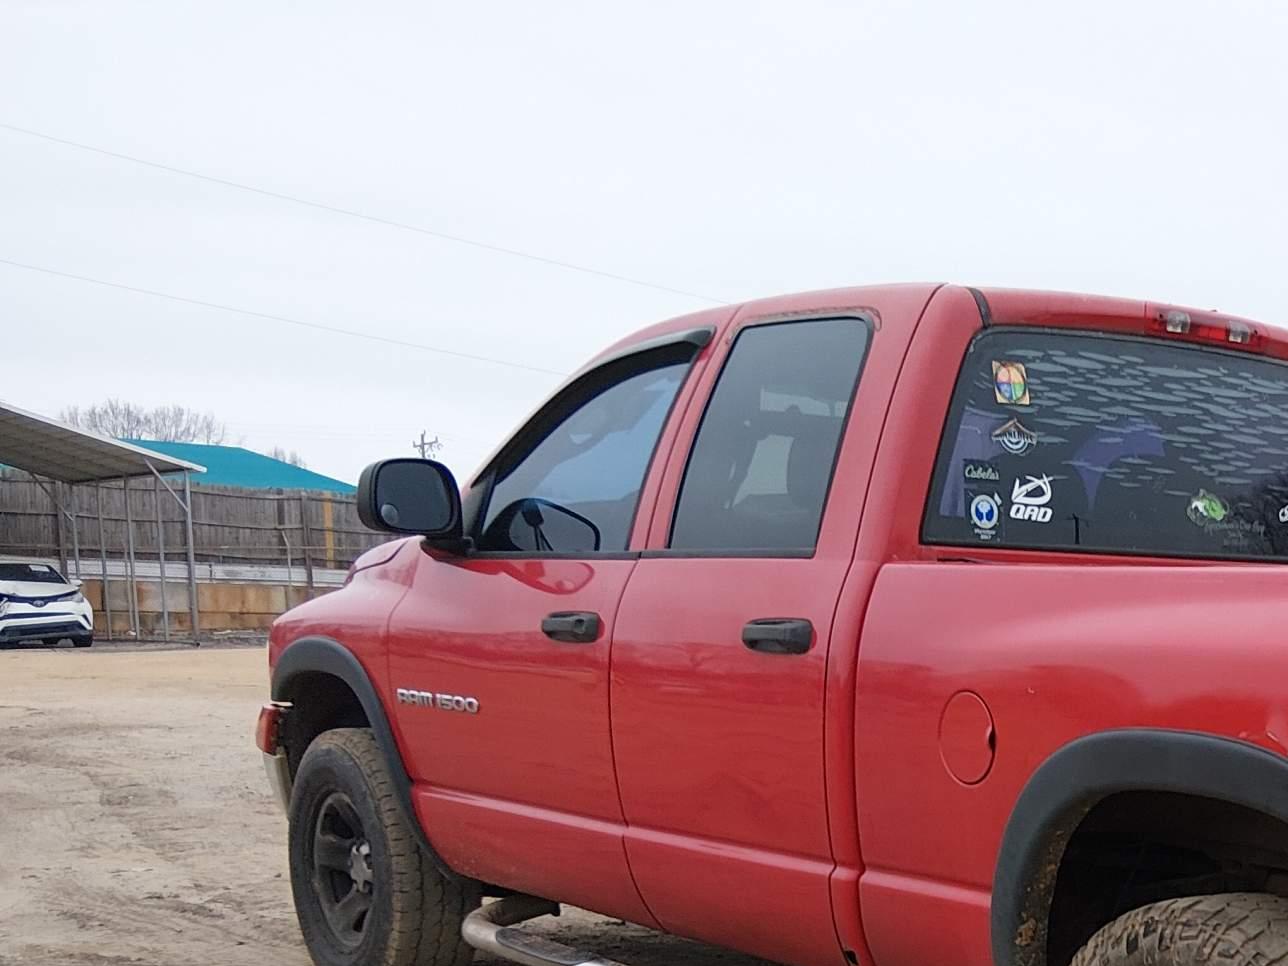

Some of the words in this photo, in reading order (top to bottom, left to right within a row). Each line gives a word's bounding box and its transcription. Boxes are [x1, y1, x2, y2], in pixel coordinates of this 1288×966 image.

[1010, 505, 1053, 522] QAD
[397, 688, 433, 707] RAM
[435, 693, 479, 713] 1500
